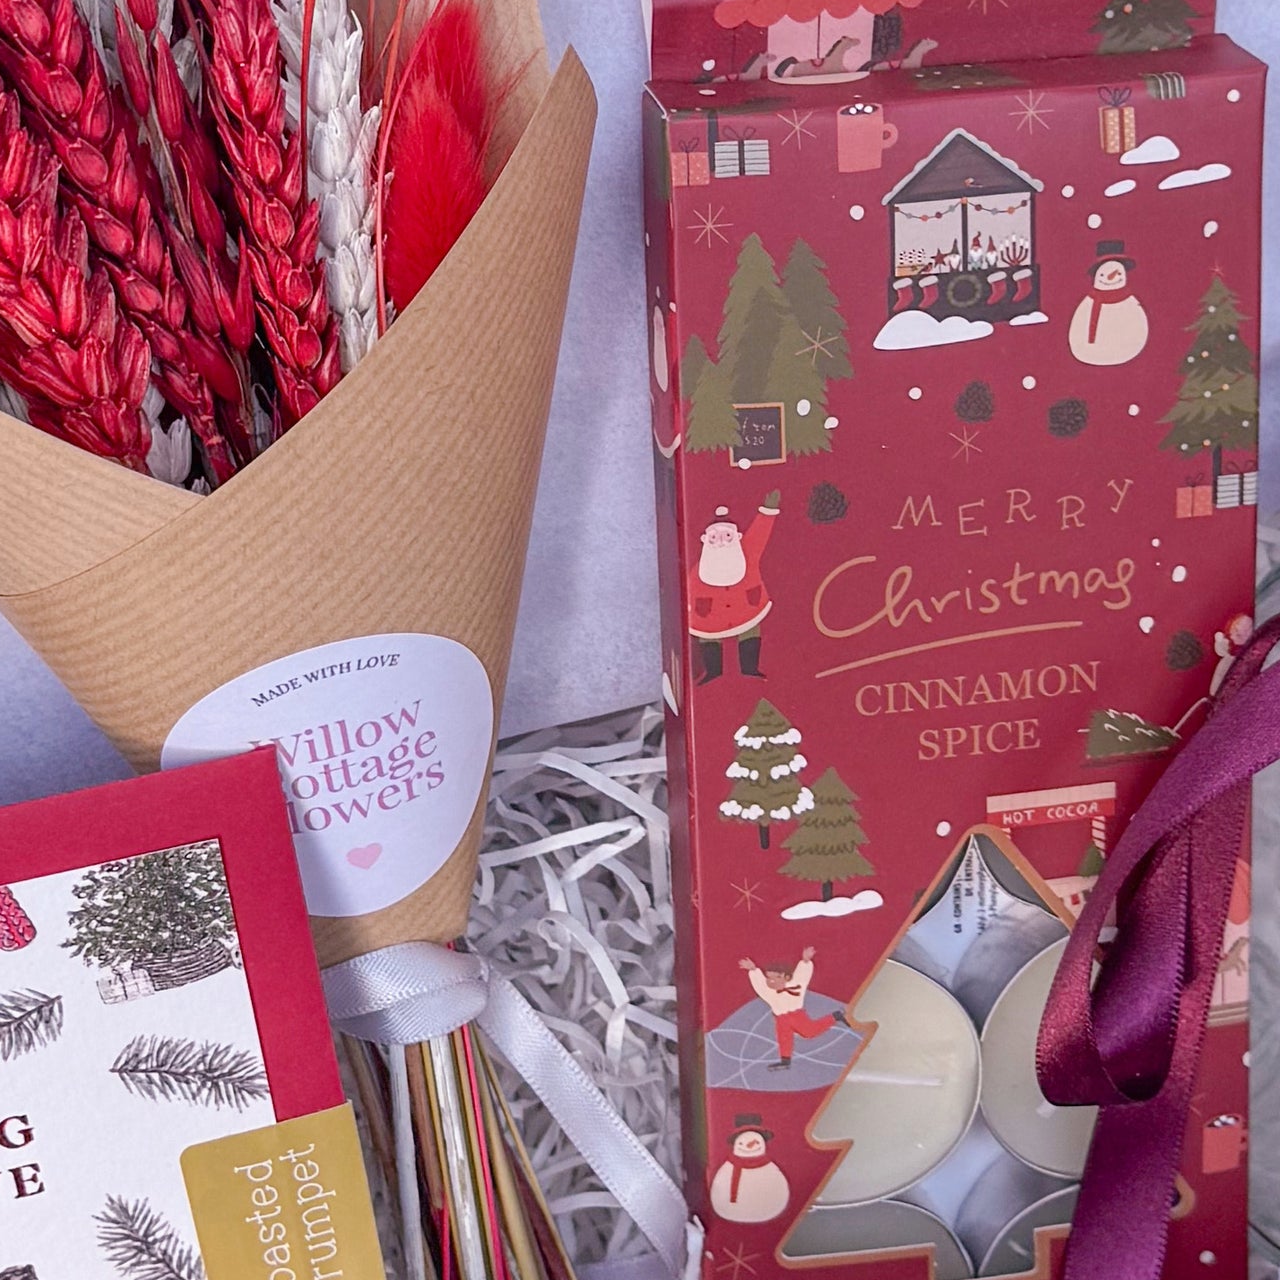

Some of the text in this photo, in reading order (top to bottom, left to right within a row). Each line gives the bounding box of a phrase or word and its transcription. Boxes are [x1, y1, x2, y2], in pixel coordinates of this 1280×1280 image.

[891, 479, 1134, 536] MERRY
[813, 556, 1135, 638] Christmas
[251, 654, 400, 707] MADE WITH LOVE
[854, 661, 1101, 717] CINNAMON
[290, 730, 438, 800] ottage
[917, 719, 1041, 761] SPICE
[287, 760, 445, 834] lowers
[1002, 801, 1099, 825] HOT COCOA
